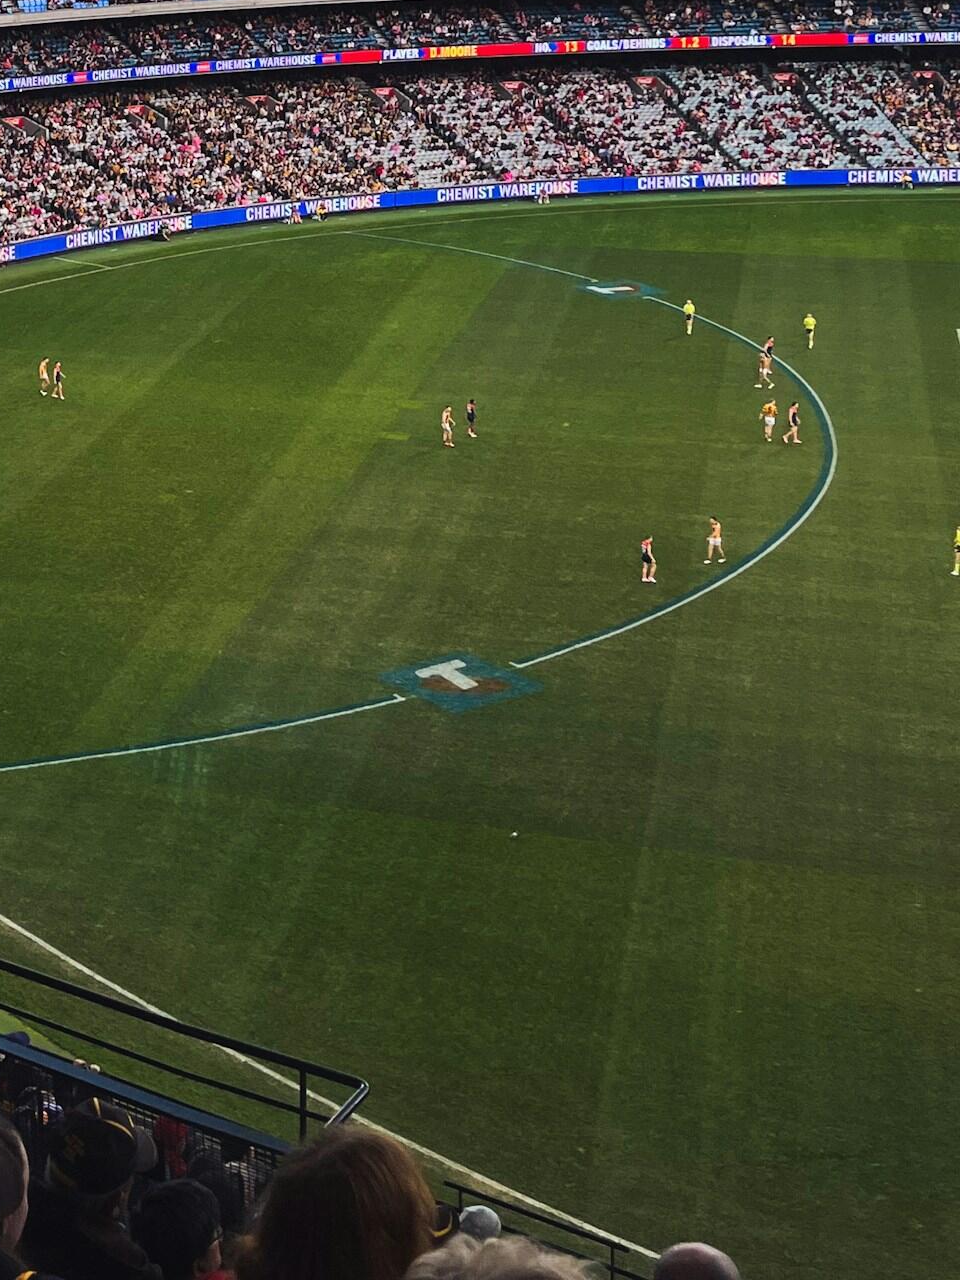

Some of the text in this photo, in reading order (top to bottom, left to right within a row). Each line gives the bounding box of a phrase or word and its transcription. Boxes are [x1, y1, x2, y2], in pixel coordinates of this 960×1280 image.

[874, 32, 921, 43] CHEMIST
[383, 48, 419, 60] PLAYER
[429, 46, 478, 58] D.MOORE
[565, 41, 578, 52] 13
[587, 38, 666, 51] GOALS/BEHINDS
[680, 38, 700, 47] 1.2
[711, 35, 766, 47] DISPOSALS
[782, 35, 796, 45] 14
[92, 67, 132, 81] CHEMIST
[135, 62, 191, 77] WAREHOUSE
[215, 54, 316, 71] CHEMIST WAREHOUSE
[13, 73, 68, 89] WAREHOUSE
[638, 172, 786, 190] CHEMIST WAREHOUSE
[437, 180, 579, 202] CHEMIST WAREHOUSE
[66, 216, 192, 248] CHEMIST WAREHUSE
